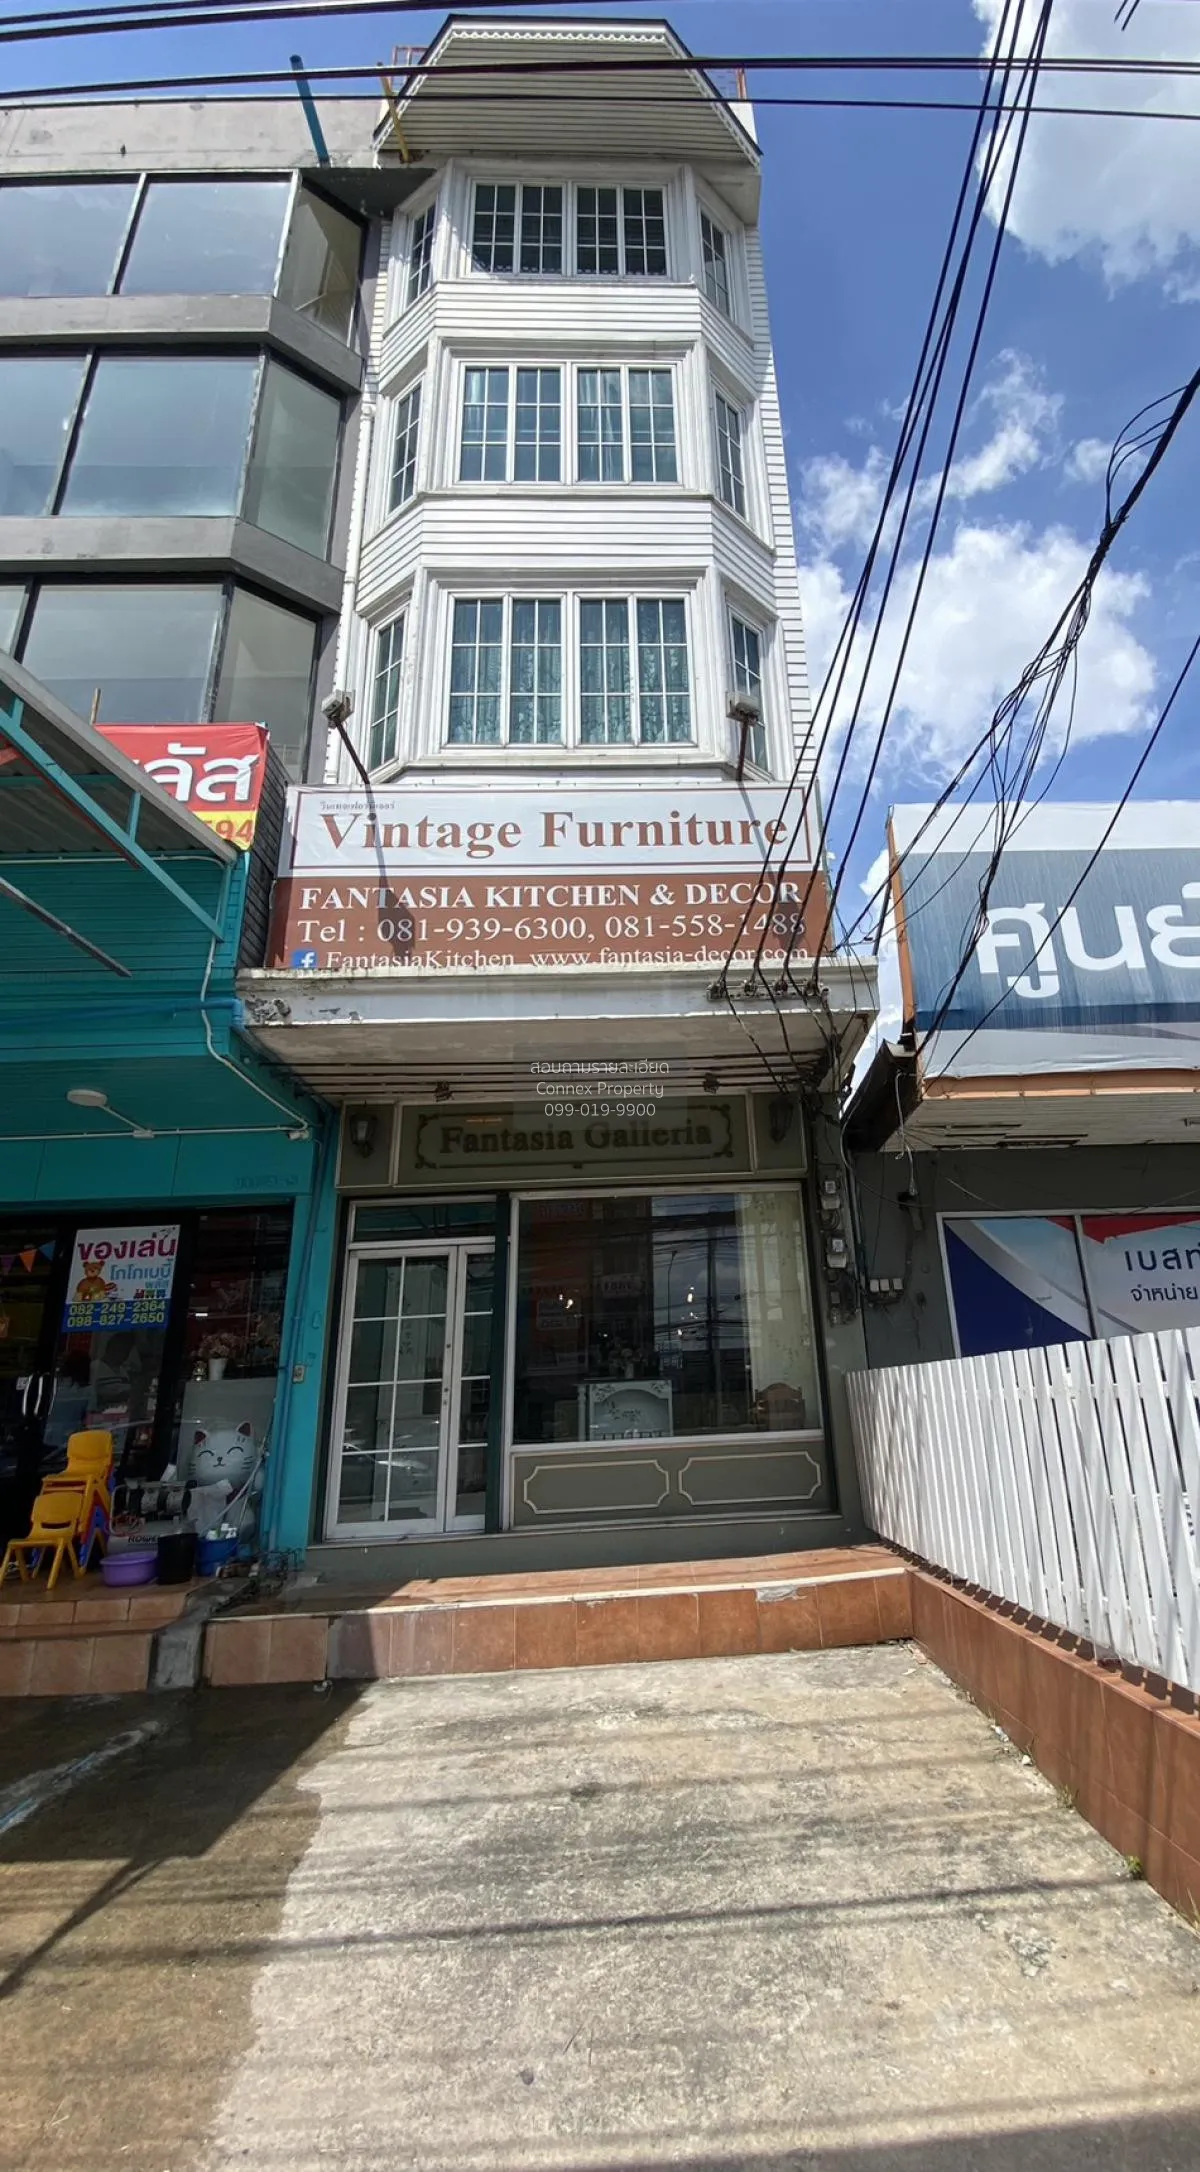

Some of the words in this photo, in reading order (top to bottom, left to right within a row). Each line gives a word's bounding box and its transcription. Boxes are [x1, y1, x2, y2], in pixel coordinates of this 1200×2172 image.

[135, 743, 259, 802] ลัส
[204, 819, 254, 843] 94
[319, 812, 521, 859] Vintage
[539, 810, 788, 848] Furniture
[299, 886, 476, 910] FANTASIA
[485, 883, 641, 908] KITCHEN
[650, 883, 676, 906] &
[685, 882, 803, 905] DECOR
[297, 918, 346, 943] Tel
[376, 915, 596, 943] 081-939-6300,
[604, 912, 805, 939] 081-558-1488
[326, 949, 515, 968] FantasiaKitchen
[440, 1122, 574, 1154] Fantasia
[584, 1119, 712, 1150] Galleria
[77, 1231, 178, 1261] ของเล่น
[1130, 1282, 1199, 1302] จำหน่าย
